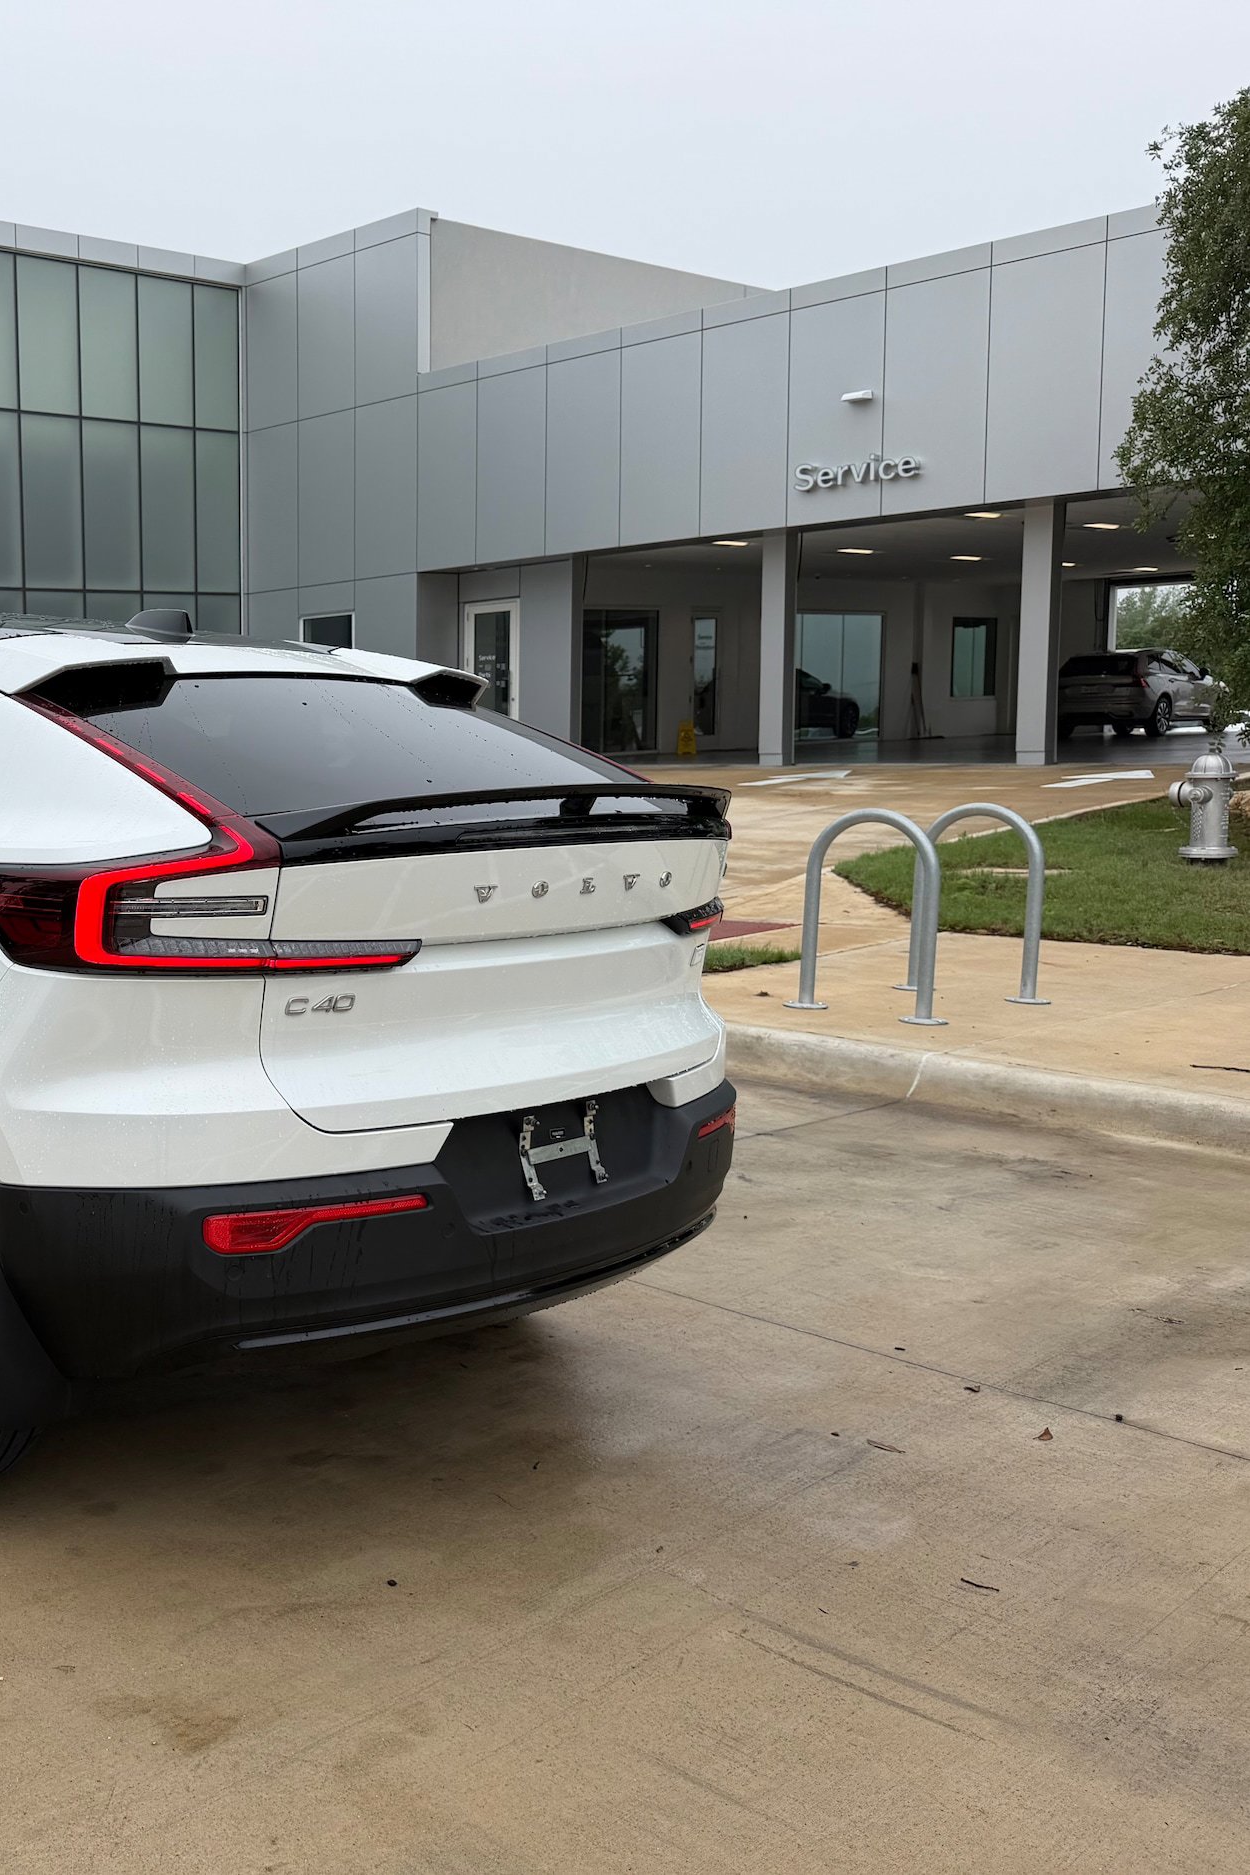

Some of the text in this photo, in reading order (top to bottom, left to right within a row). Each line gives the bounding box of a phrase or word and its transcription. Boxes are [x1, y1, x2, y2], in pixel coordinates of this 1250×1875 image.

[794, 453, 919, 491] Service
[473, 871, 672, 904] VOLVO
[285, 993, 356, 1016] C40
